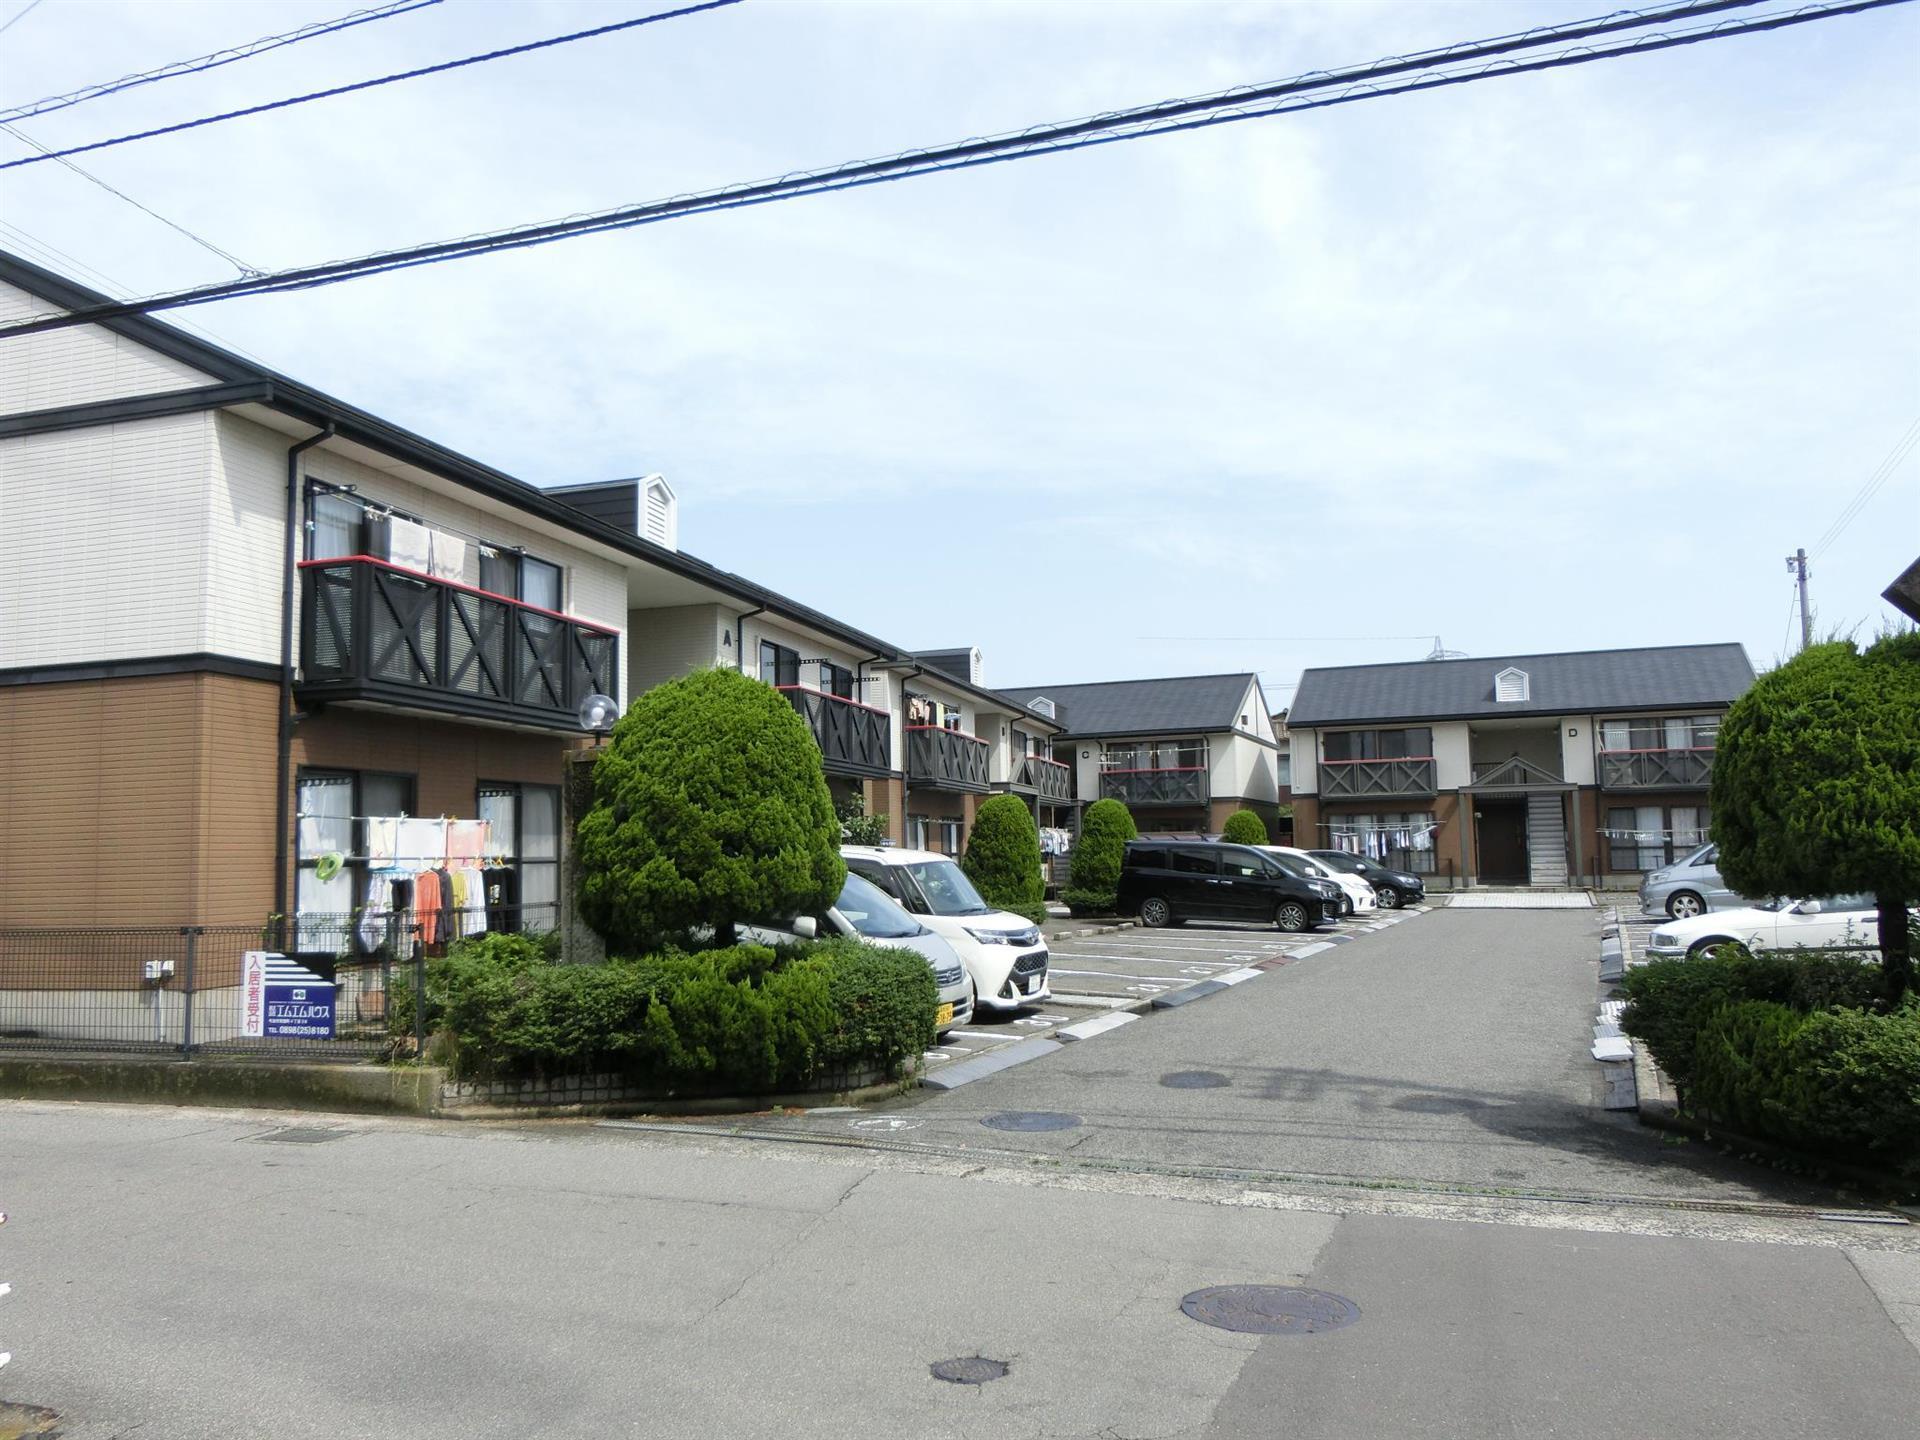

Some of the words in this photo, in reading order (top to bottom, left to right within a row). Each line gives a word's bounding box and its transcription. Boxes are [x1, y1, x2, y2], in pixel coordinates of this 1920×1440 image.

[723, 629, 732, 647] A
[1568, 728, 1578, 738] D
[1081, 750, 1090, 760] C
[246, 955, 261, 1033] 入居者受付
